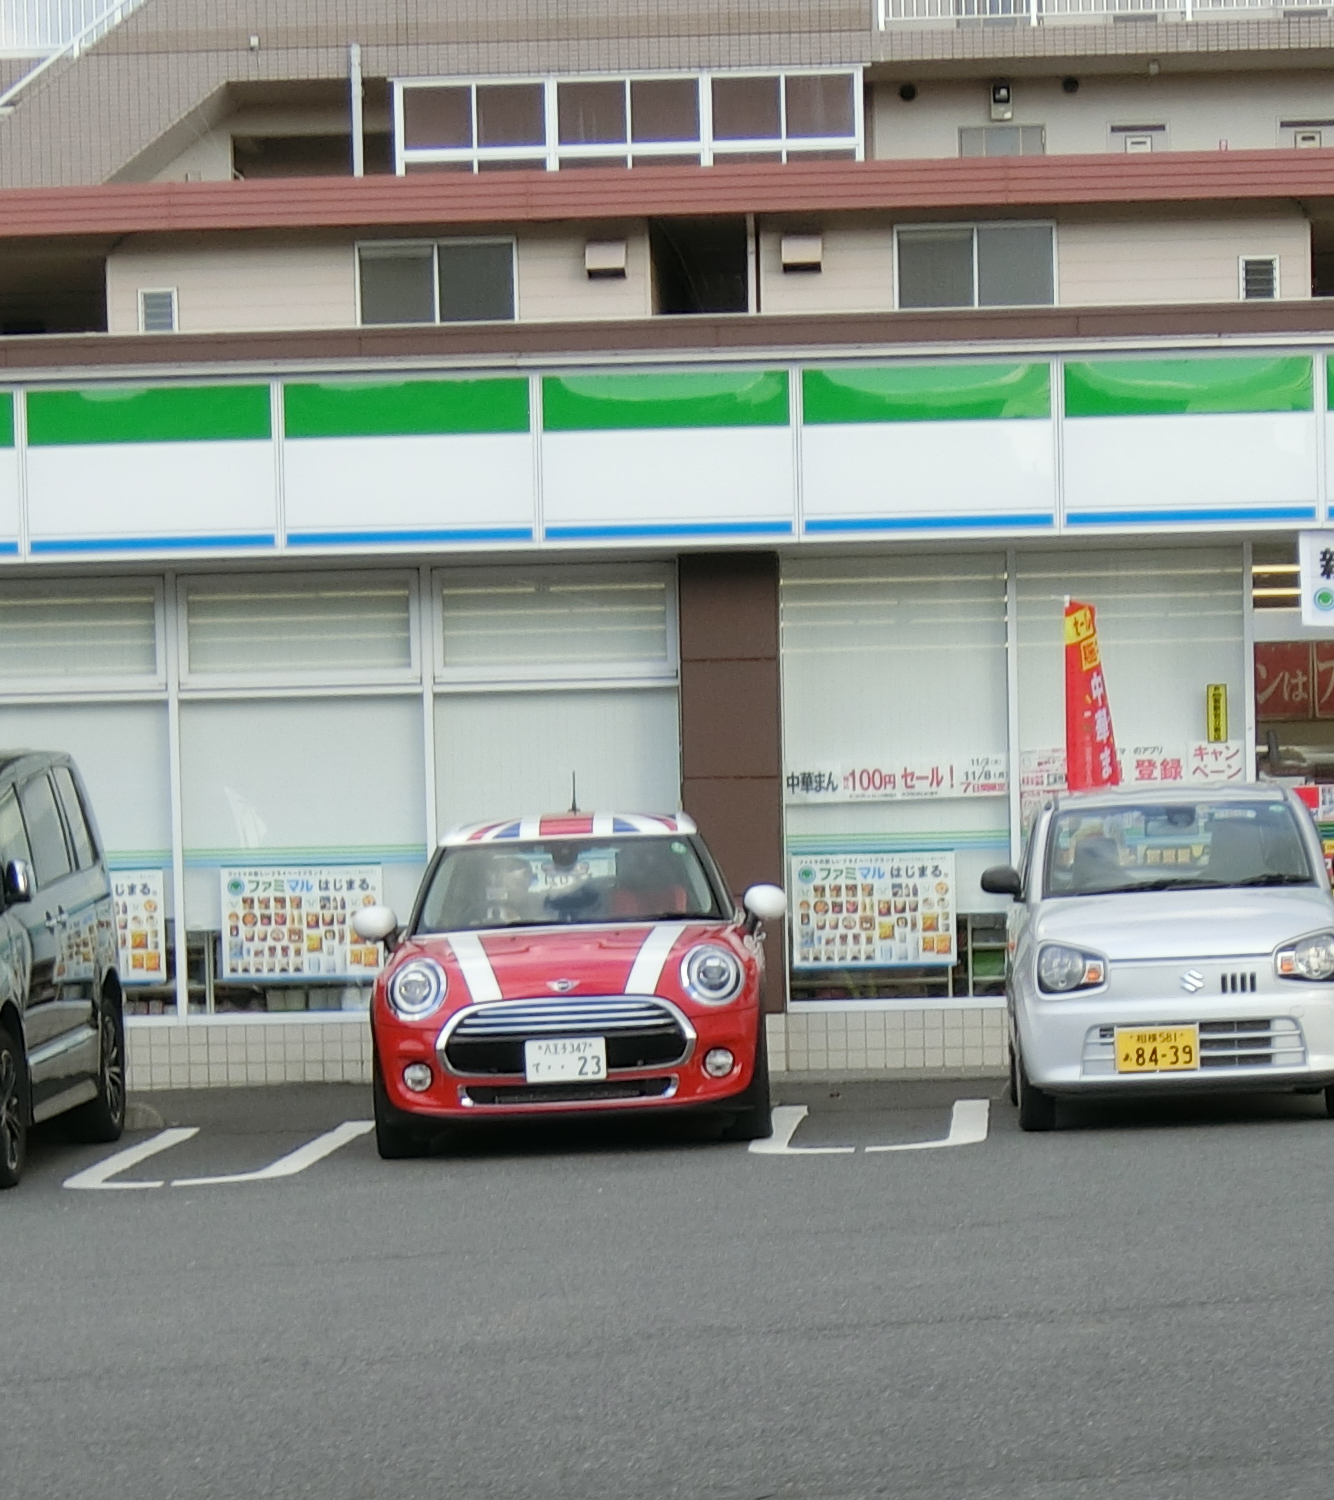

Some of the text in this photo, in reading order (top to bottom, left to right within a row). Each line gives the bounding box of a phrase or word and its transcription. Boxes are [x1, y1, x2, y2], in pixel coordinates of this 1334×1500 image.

[1193, 745, 1240, 762] キャン
[786, 771, 839, 794] 中華まん
[819, 865, 885, 881] ファミマル
[114, 883, 158, 897] じまる。
[248, 879, 314, 893] ファミマル
[1135, 1045, 1193, 1067] 84-39
